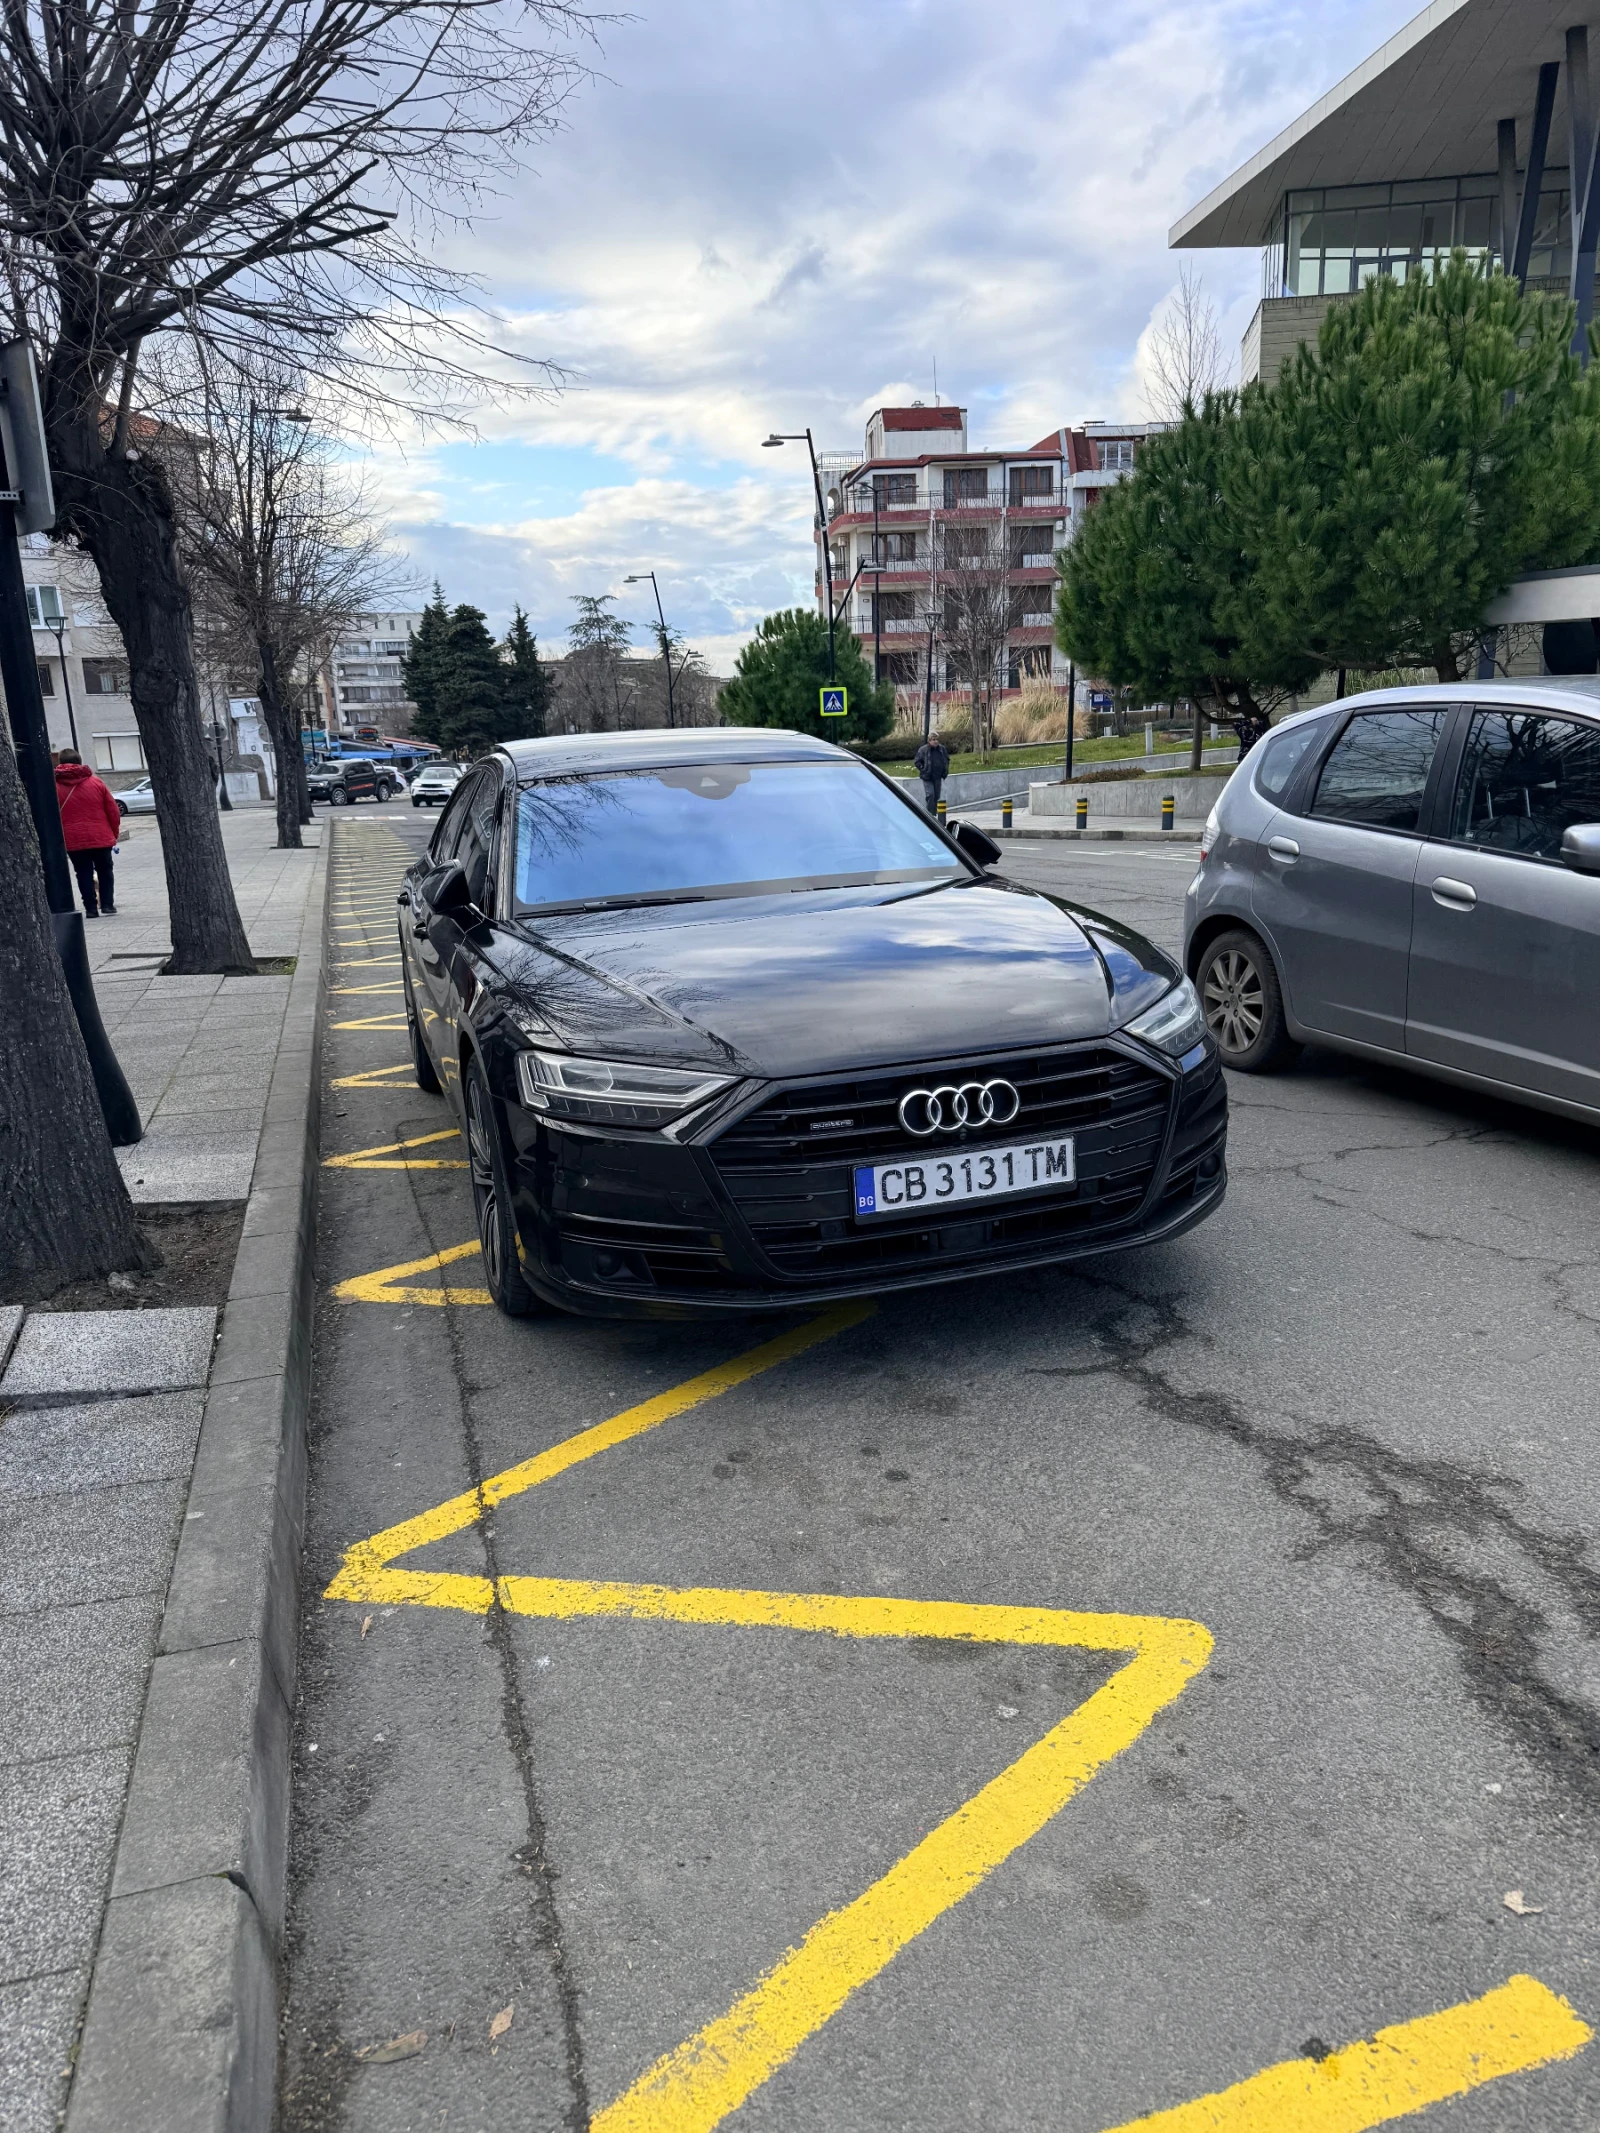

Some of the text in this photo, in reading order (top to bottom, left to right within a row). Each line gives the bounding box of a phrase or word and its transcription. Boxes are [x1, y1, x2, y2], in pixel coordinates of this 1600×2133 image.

[881, 1144, 1067, 1204] CB 3131 TM
[859, 1195, 874, 1208] BG
